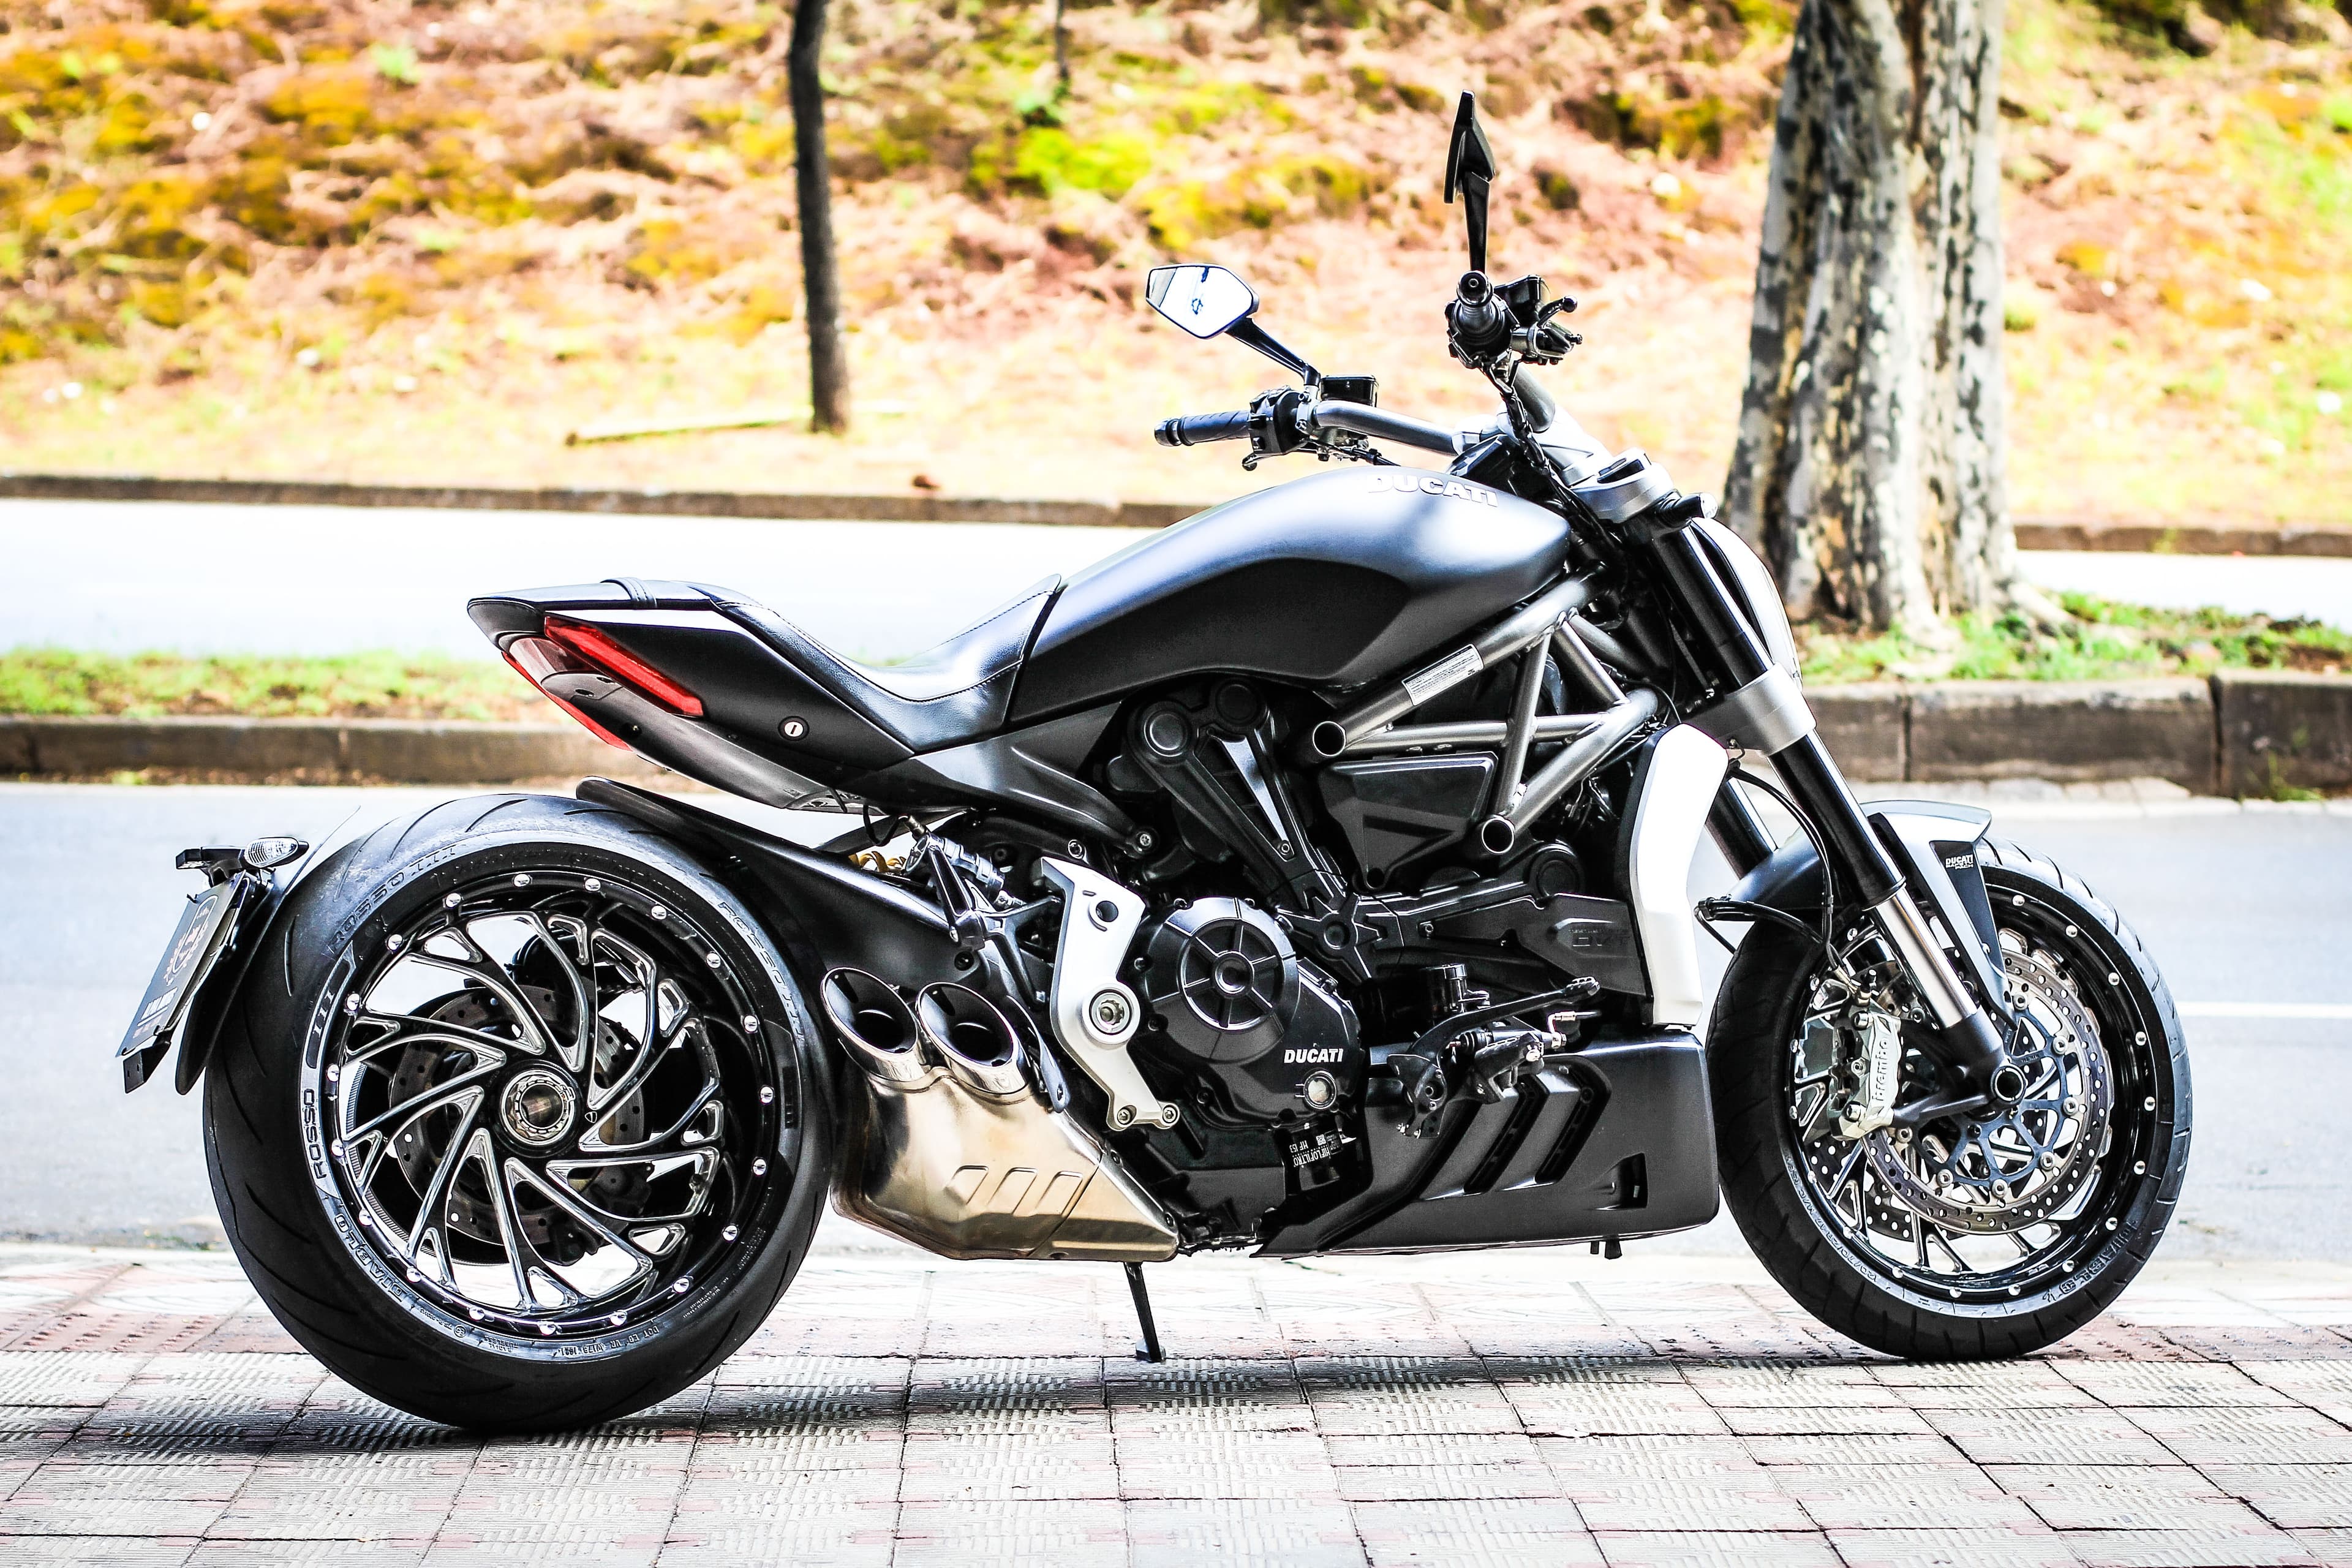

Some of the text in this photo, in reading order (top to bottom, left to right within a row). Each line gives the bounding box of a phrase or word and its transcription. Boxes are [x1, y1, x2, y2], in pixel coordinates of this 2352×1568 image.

[1368, 474, 1498, 507] DUCATI
[1945, 854, 1973, 865] DUCATI
[326, 872, 404, 953] ROSSO
[1284, 1048, 1344, 1064] DUCATI
[1872, 1037, 1889, 1101] brembo
[304, 989, 336, 1180] ROSSO III
[1289, 1140, 1309, 1153] HF 153
[1293, 1147, 1331, 1167] HIFLOFILTRO
[334, 1213, 407, 1302] DIABLO
[2059, 1223, 2136, 1294] DIABLO
[482, 1335, 519, 1349] TUBELESS
[641, 1324, 660, 1339] DOT
